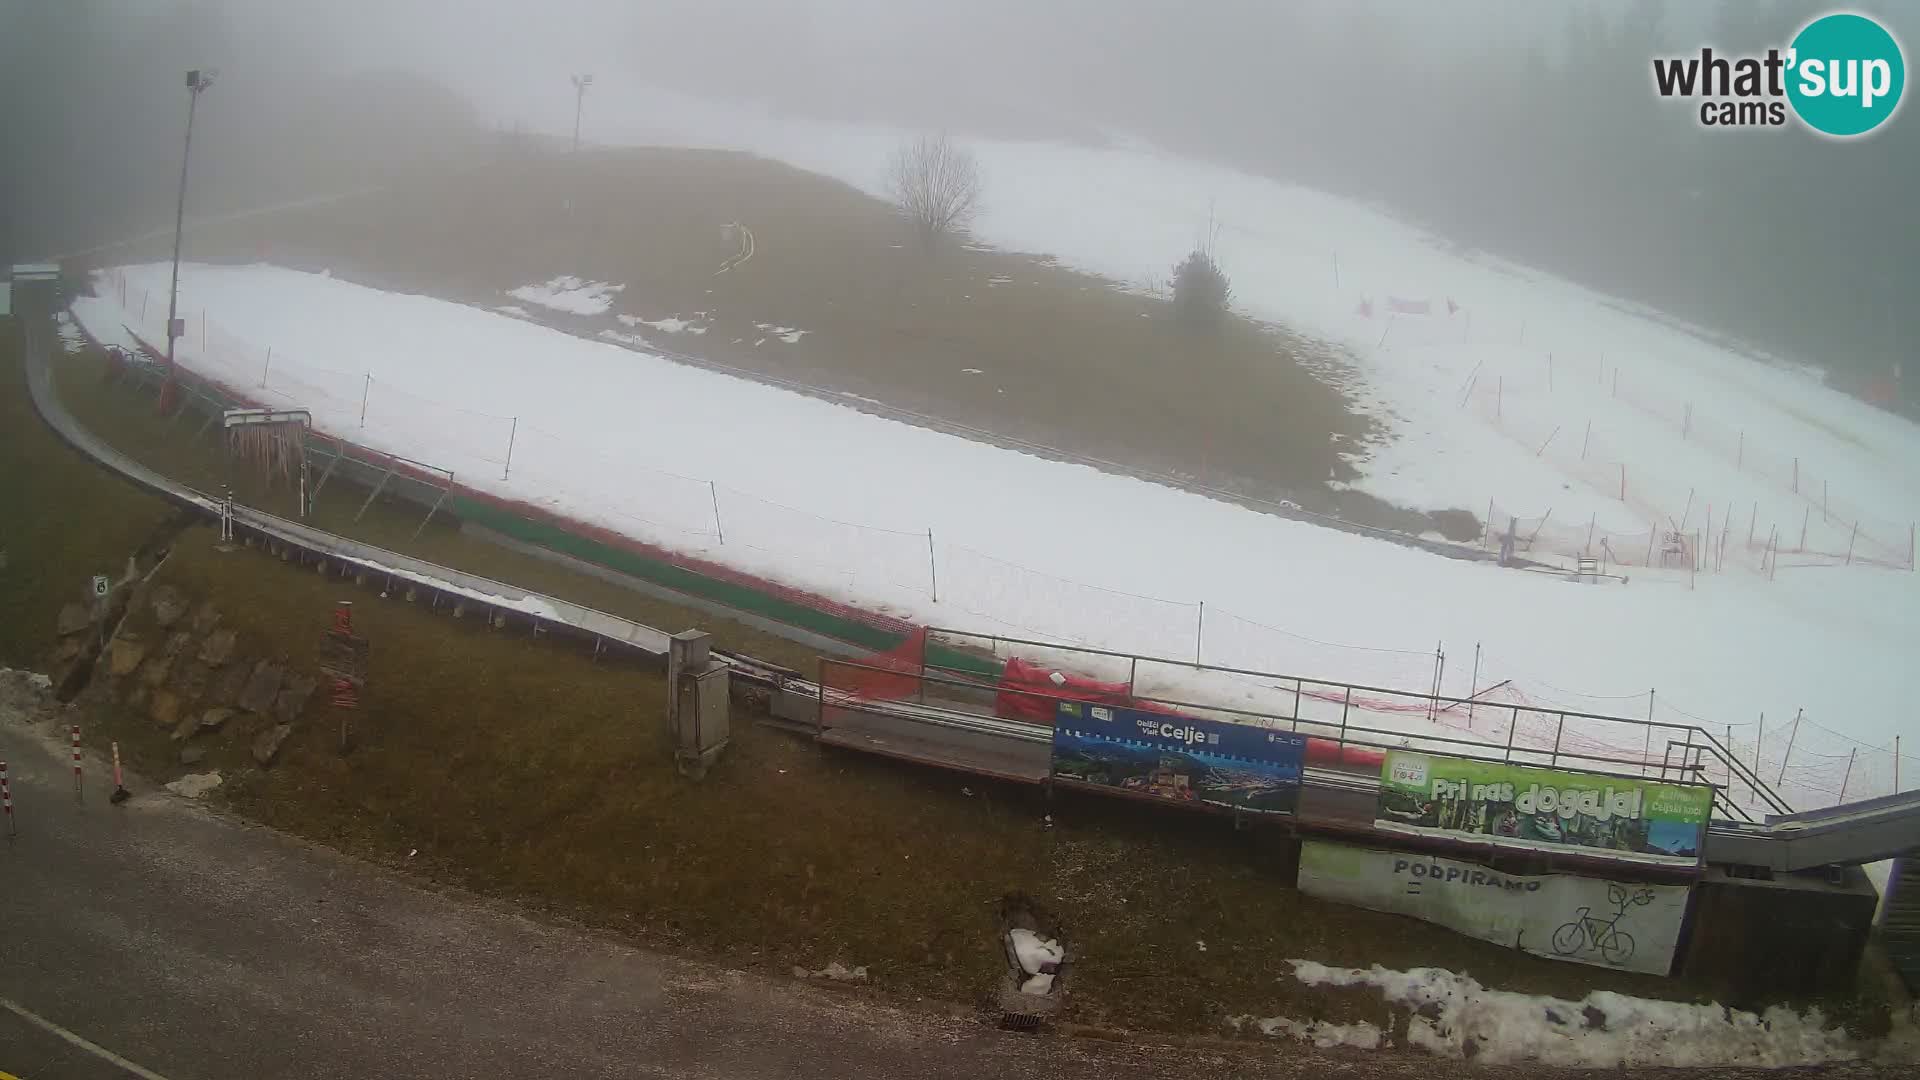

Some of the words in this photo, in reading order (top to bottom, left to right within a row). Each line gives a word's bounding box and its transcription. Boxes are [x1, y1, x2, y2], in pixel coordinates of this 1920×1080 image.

[1160, 723, 1205, 745] Celje
[1430, 778, 1467, 801] Pri
[1472, 782, 1514, 802] nas
[1394, 859, 1541, 892] PODPIRAMO
